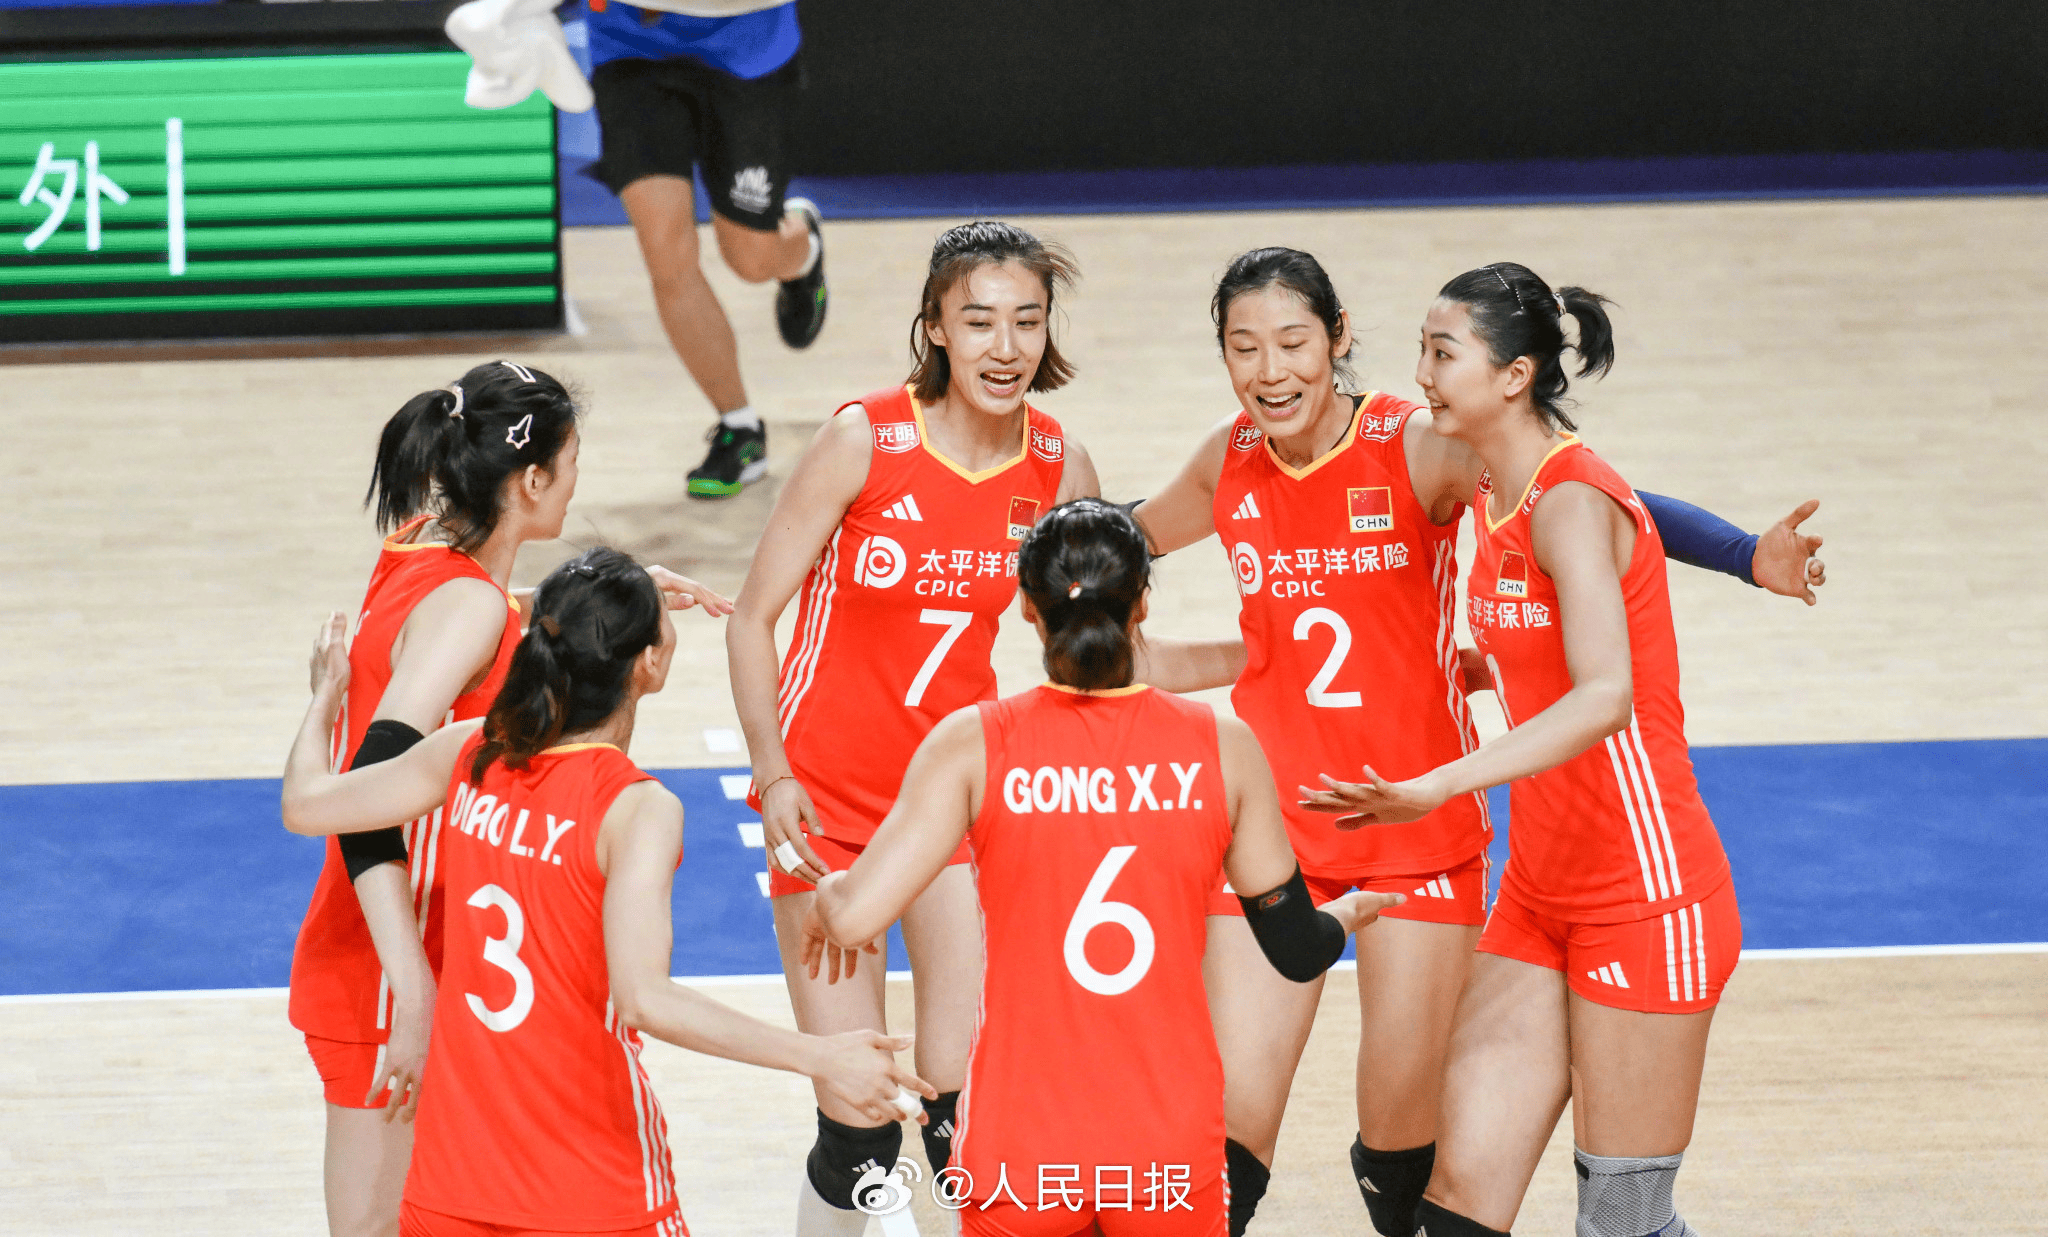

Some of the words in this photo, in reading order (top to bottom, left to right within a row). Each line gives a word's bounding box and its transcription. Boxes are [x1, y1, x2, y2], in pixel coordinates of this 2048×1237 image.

[877, 424, 917, 443] 光明
[1364, 415, 1401, 434] 光明
[1032, 429, 1062, 454] 光明
[1355, 516, 1388, 530] CHN
[917, 548, 1019, 578] 太平洋保
[1267, 542, 1409, 576] 太平洋保险
[914, 579, 970, 598] CPIC
[1271, 580, 1325, 599] CPIC
[1499, 581, 1523, 594] CHN
[904, 608, 973, 707] 7
[1293, 606, 1362, 708] 2
[1003, 766, 1117, 814] GONG
[1126, 762, 1203, 812] X.Y.
[449, 781, 510, 847] DIAO
[509, 808, 576, 865] L.Y.
[1063, 845, 1155, 995] 6
[464, 883, 535, 1032] 3
